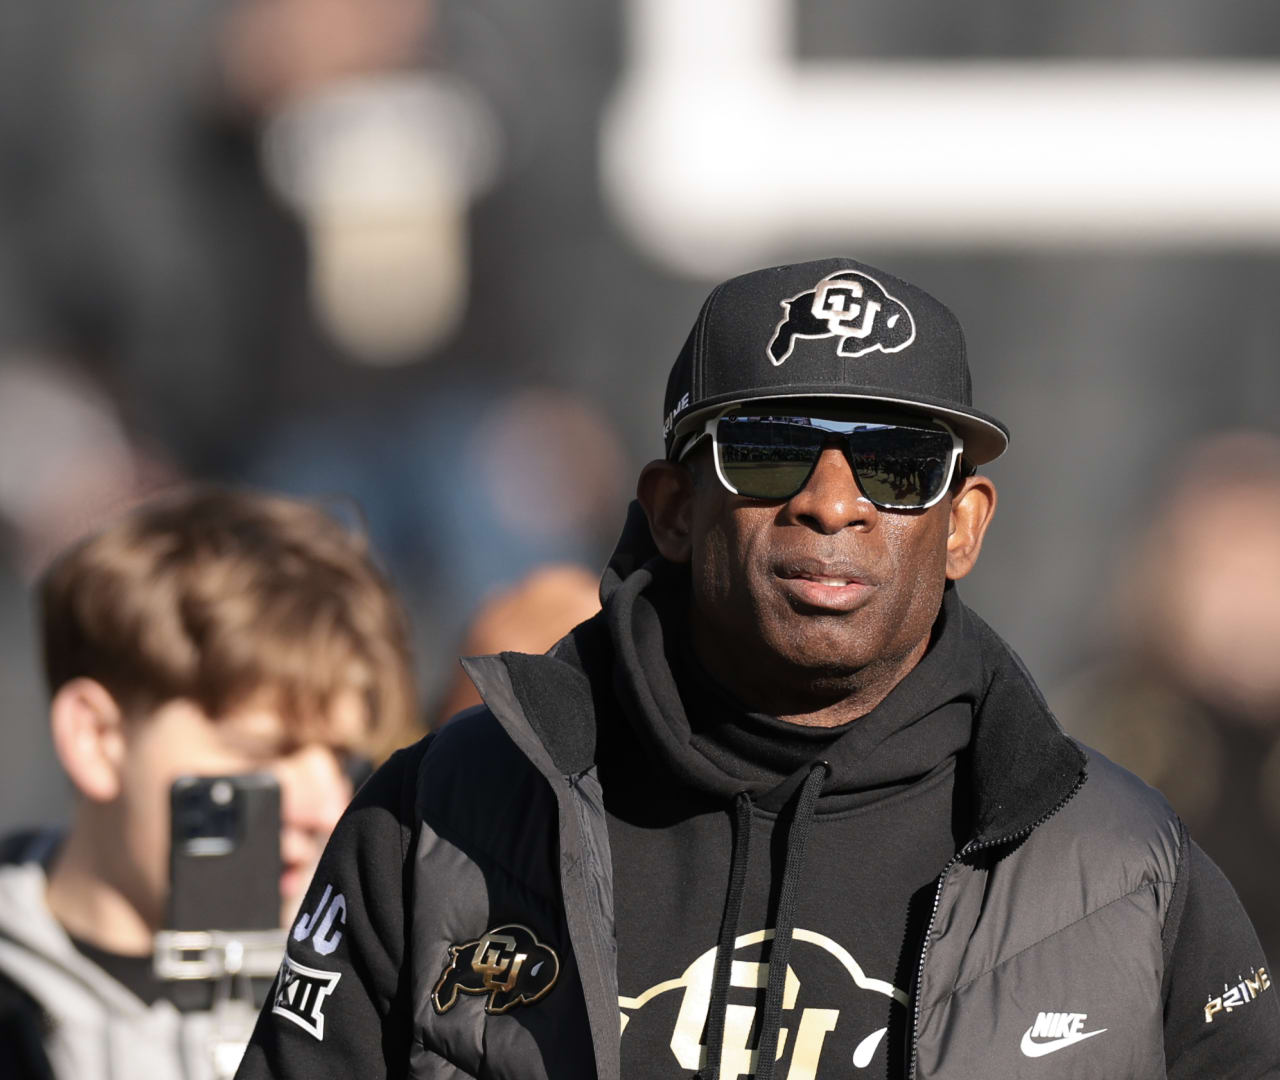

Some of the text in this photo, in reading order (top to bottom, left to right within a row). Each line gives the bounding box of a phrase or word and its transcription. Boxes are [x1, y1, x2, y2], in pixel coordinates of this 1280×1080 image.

[293, 883, 346, 956] JC
[472, 933, 528, 992] CU
[1031, 1012, 1067, 1038] NIKE
